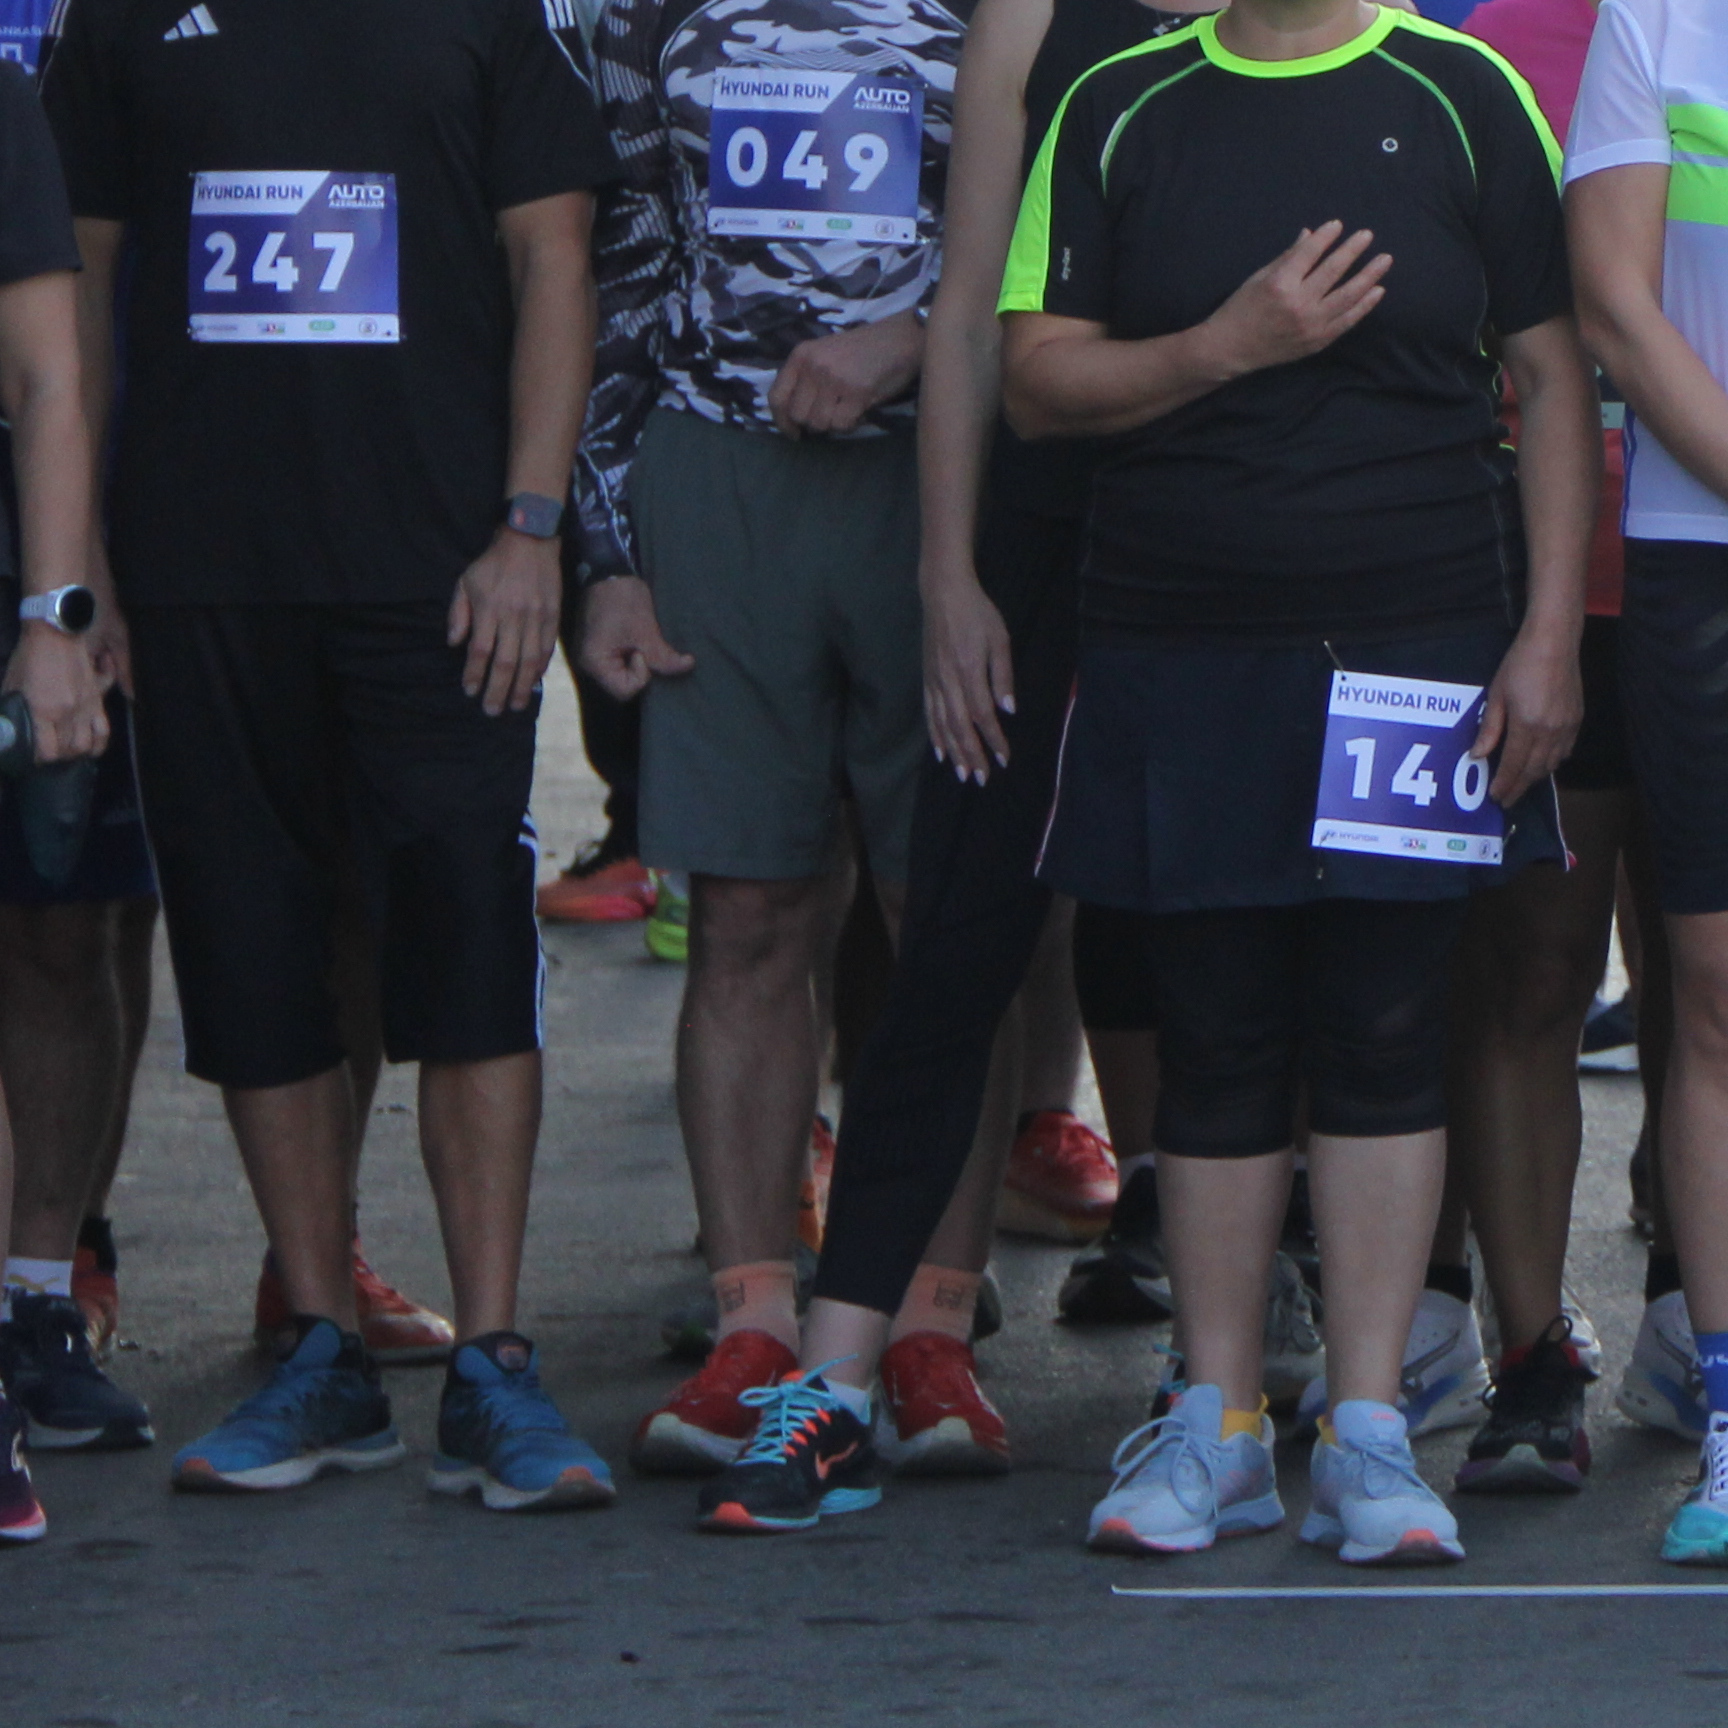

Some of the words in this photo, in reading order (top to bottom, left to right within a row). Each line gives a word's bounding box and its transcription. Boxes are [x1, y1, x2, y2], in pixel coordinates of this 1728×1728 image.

[720, 78, 789, 98] HYUNDAI
[794, 83, 830, 99] RUN
[854, 86, 911, 104] AUTO
[726, 126, 889, 191] 049
[197, 184, 260, 200] HYUNDAI
[266, 184, 303, 200] RUN
[328, 184, 385, 200] AUTO
[204, 230, 355, 292] 247
[1337, 685, 1421, 709] HYUNDAI
[1426, 696, 1462, 714] RUN
[1345, 737, 1489, 812] 140
